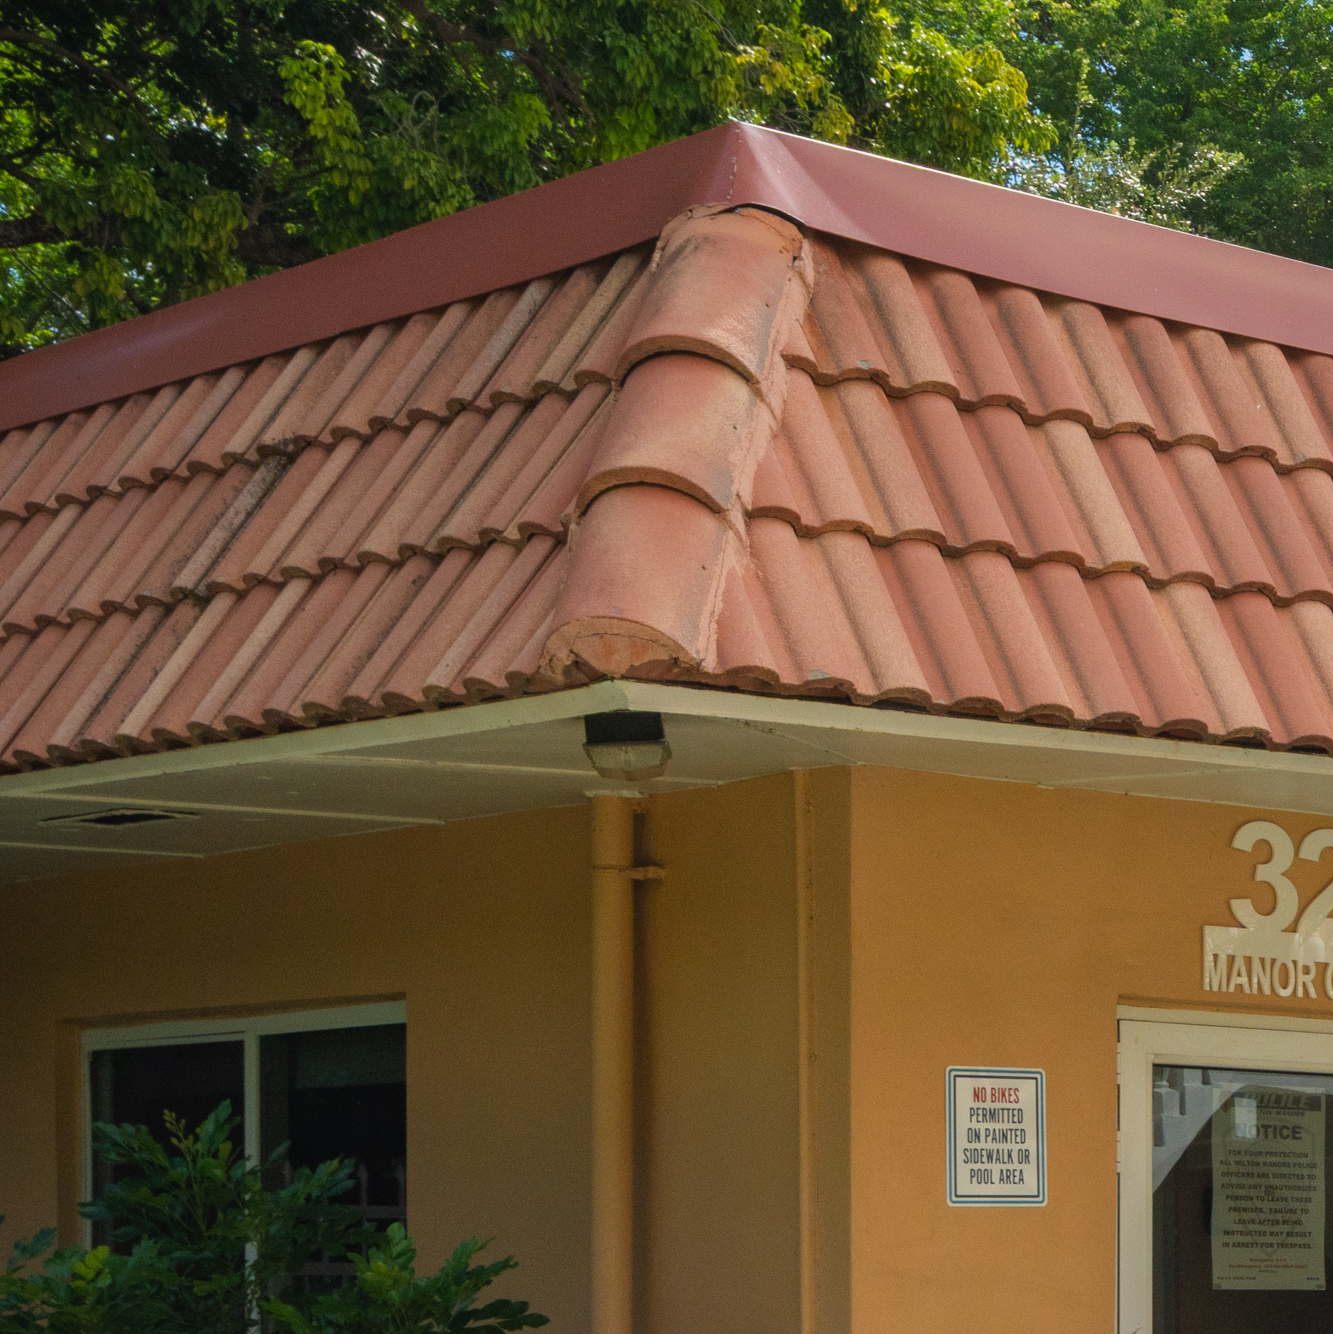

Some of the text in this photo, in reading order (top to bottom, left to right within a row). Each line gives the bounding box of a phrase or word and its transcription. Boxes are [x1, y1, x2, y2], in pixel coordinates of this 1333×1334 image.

[1203, 953, 1317, 998] MANOR
[973, 1086, 1020, 1104] NO BIKES
[1243, 1091, 1311, 1109] POLICE
[969, 1107, 1024, 1124] PERMITTED
[967, 1127, 1026, 1144] ON PAINTED
[1235, 1123, 1302, 1140] NOTICE
[963, 1148, 1031, 1165] SIDEWALK OR
[1264, 1150, 1309, 1158] PROTECTION
[969, 1168, 1025, 1185] POOL AREA
[1221, 1171, 1254, 1179] OFFICERS
[1264, 1184, 1317, 1192] UNAUTHORIZED
